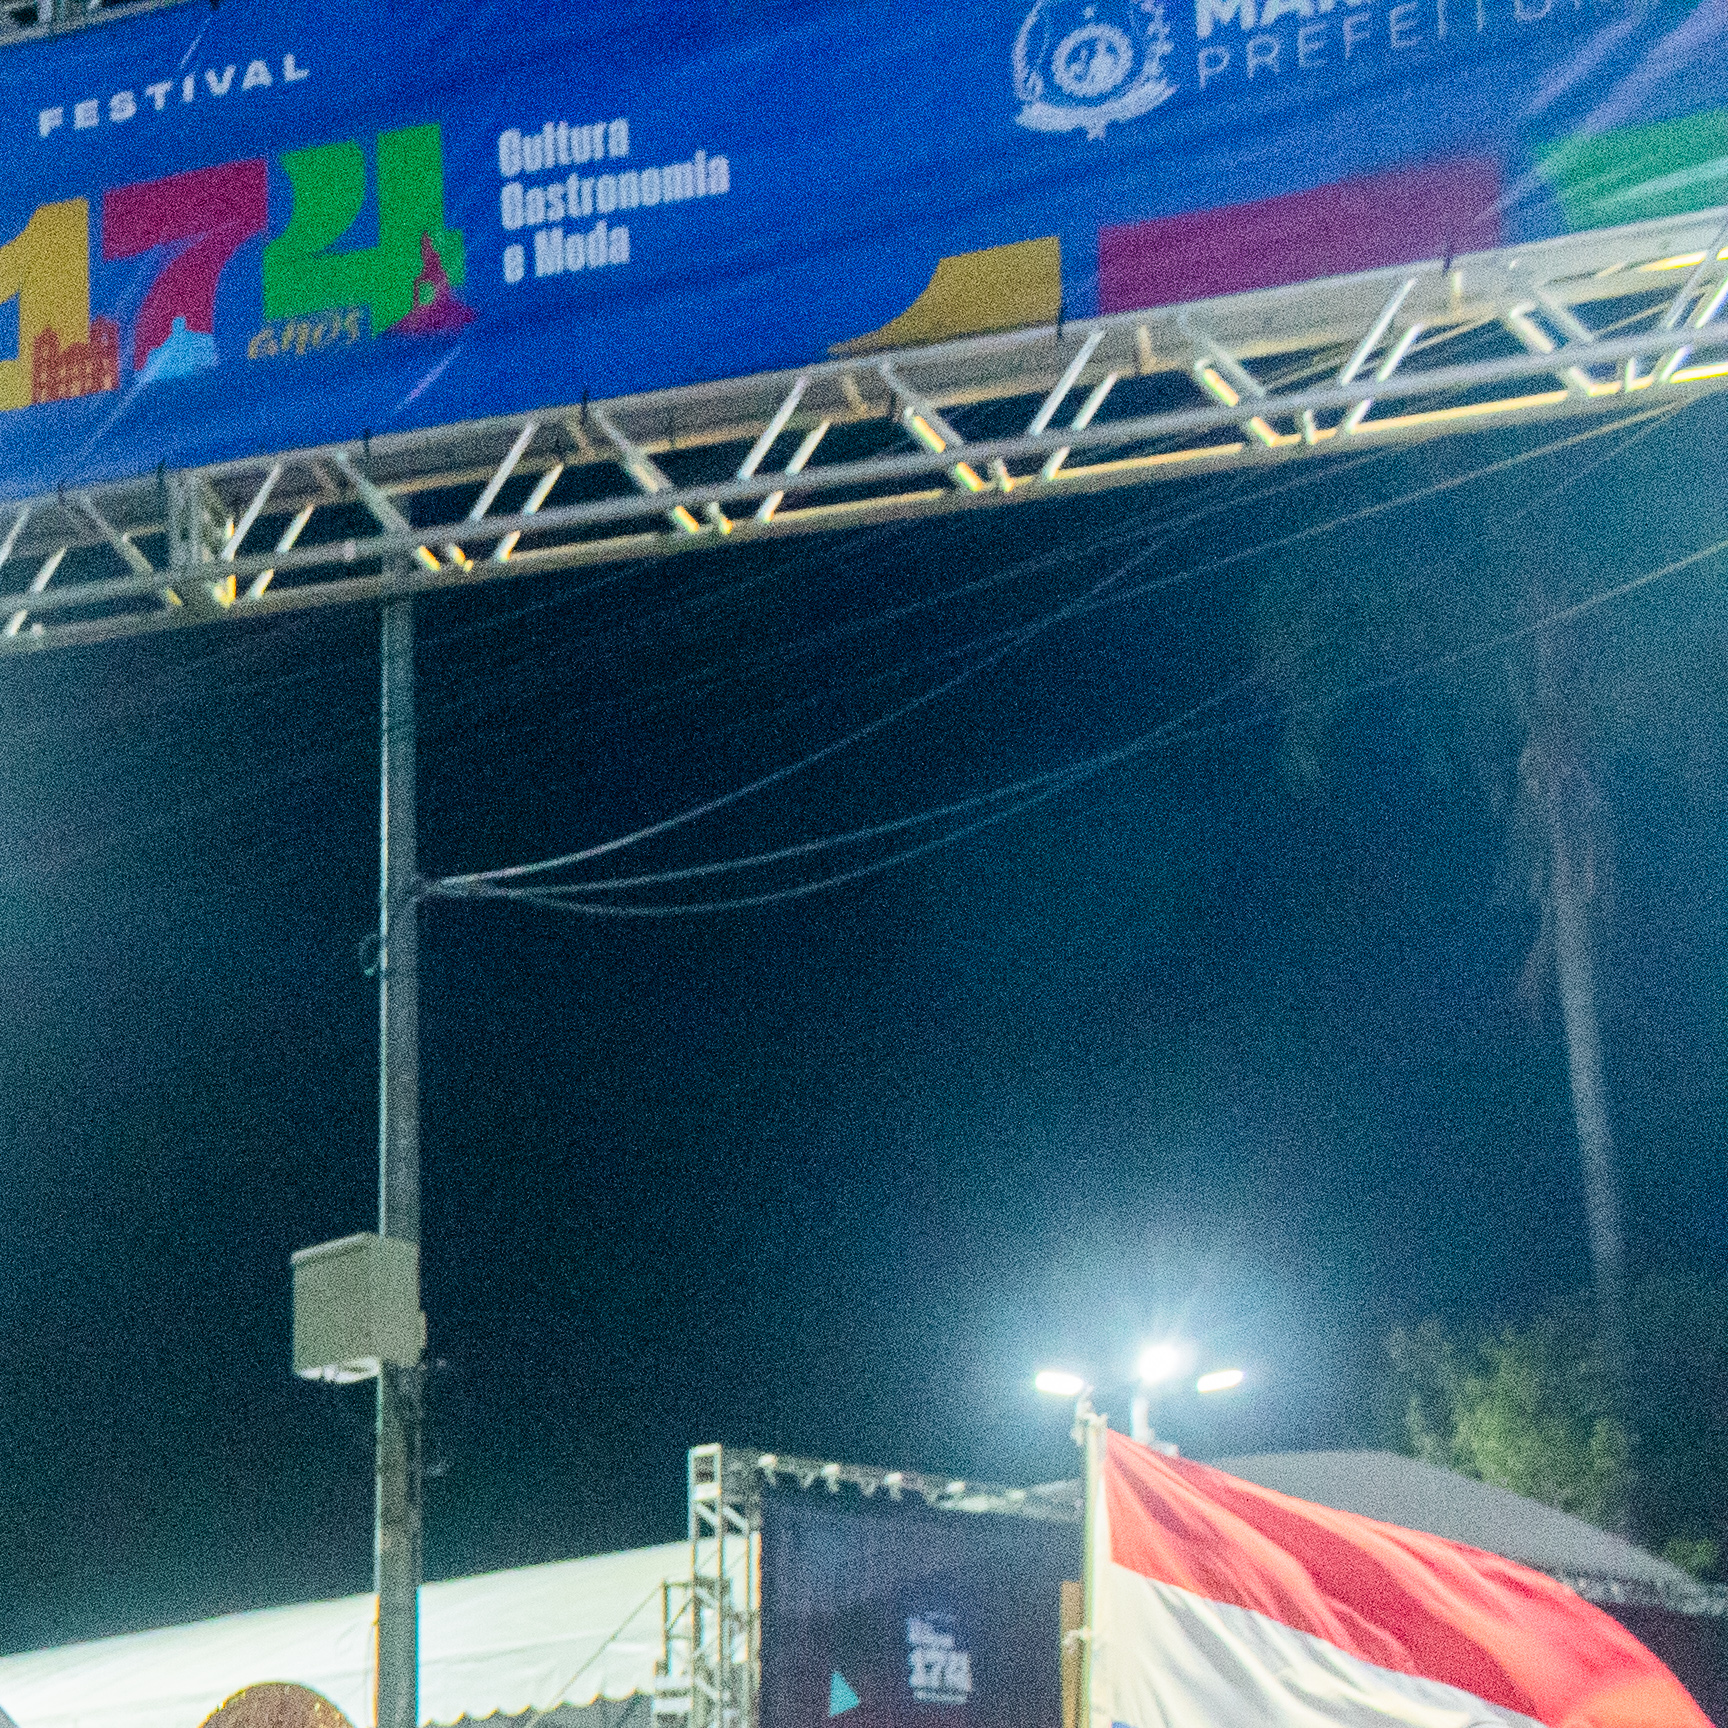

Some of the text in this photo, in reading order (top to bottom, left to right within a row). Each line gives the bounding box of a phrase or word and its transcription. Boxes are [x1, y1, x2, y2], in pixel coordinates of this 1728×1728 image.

[38, 53, 310, 138] FESTIVAL
[498, 117, 629, 178] Cultura
[501, 148, 730, 230] Gastronomia
[504, 219, 630, 284] e Moda
